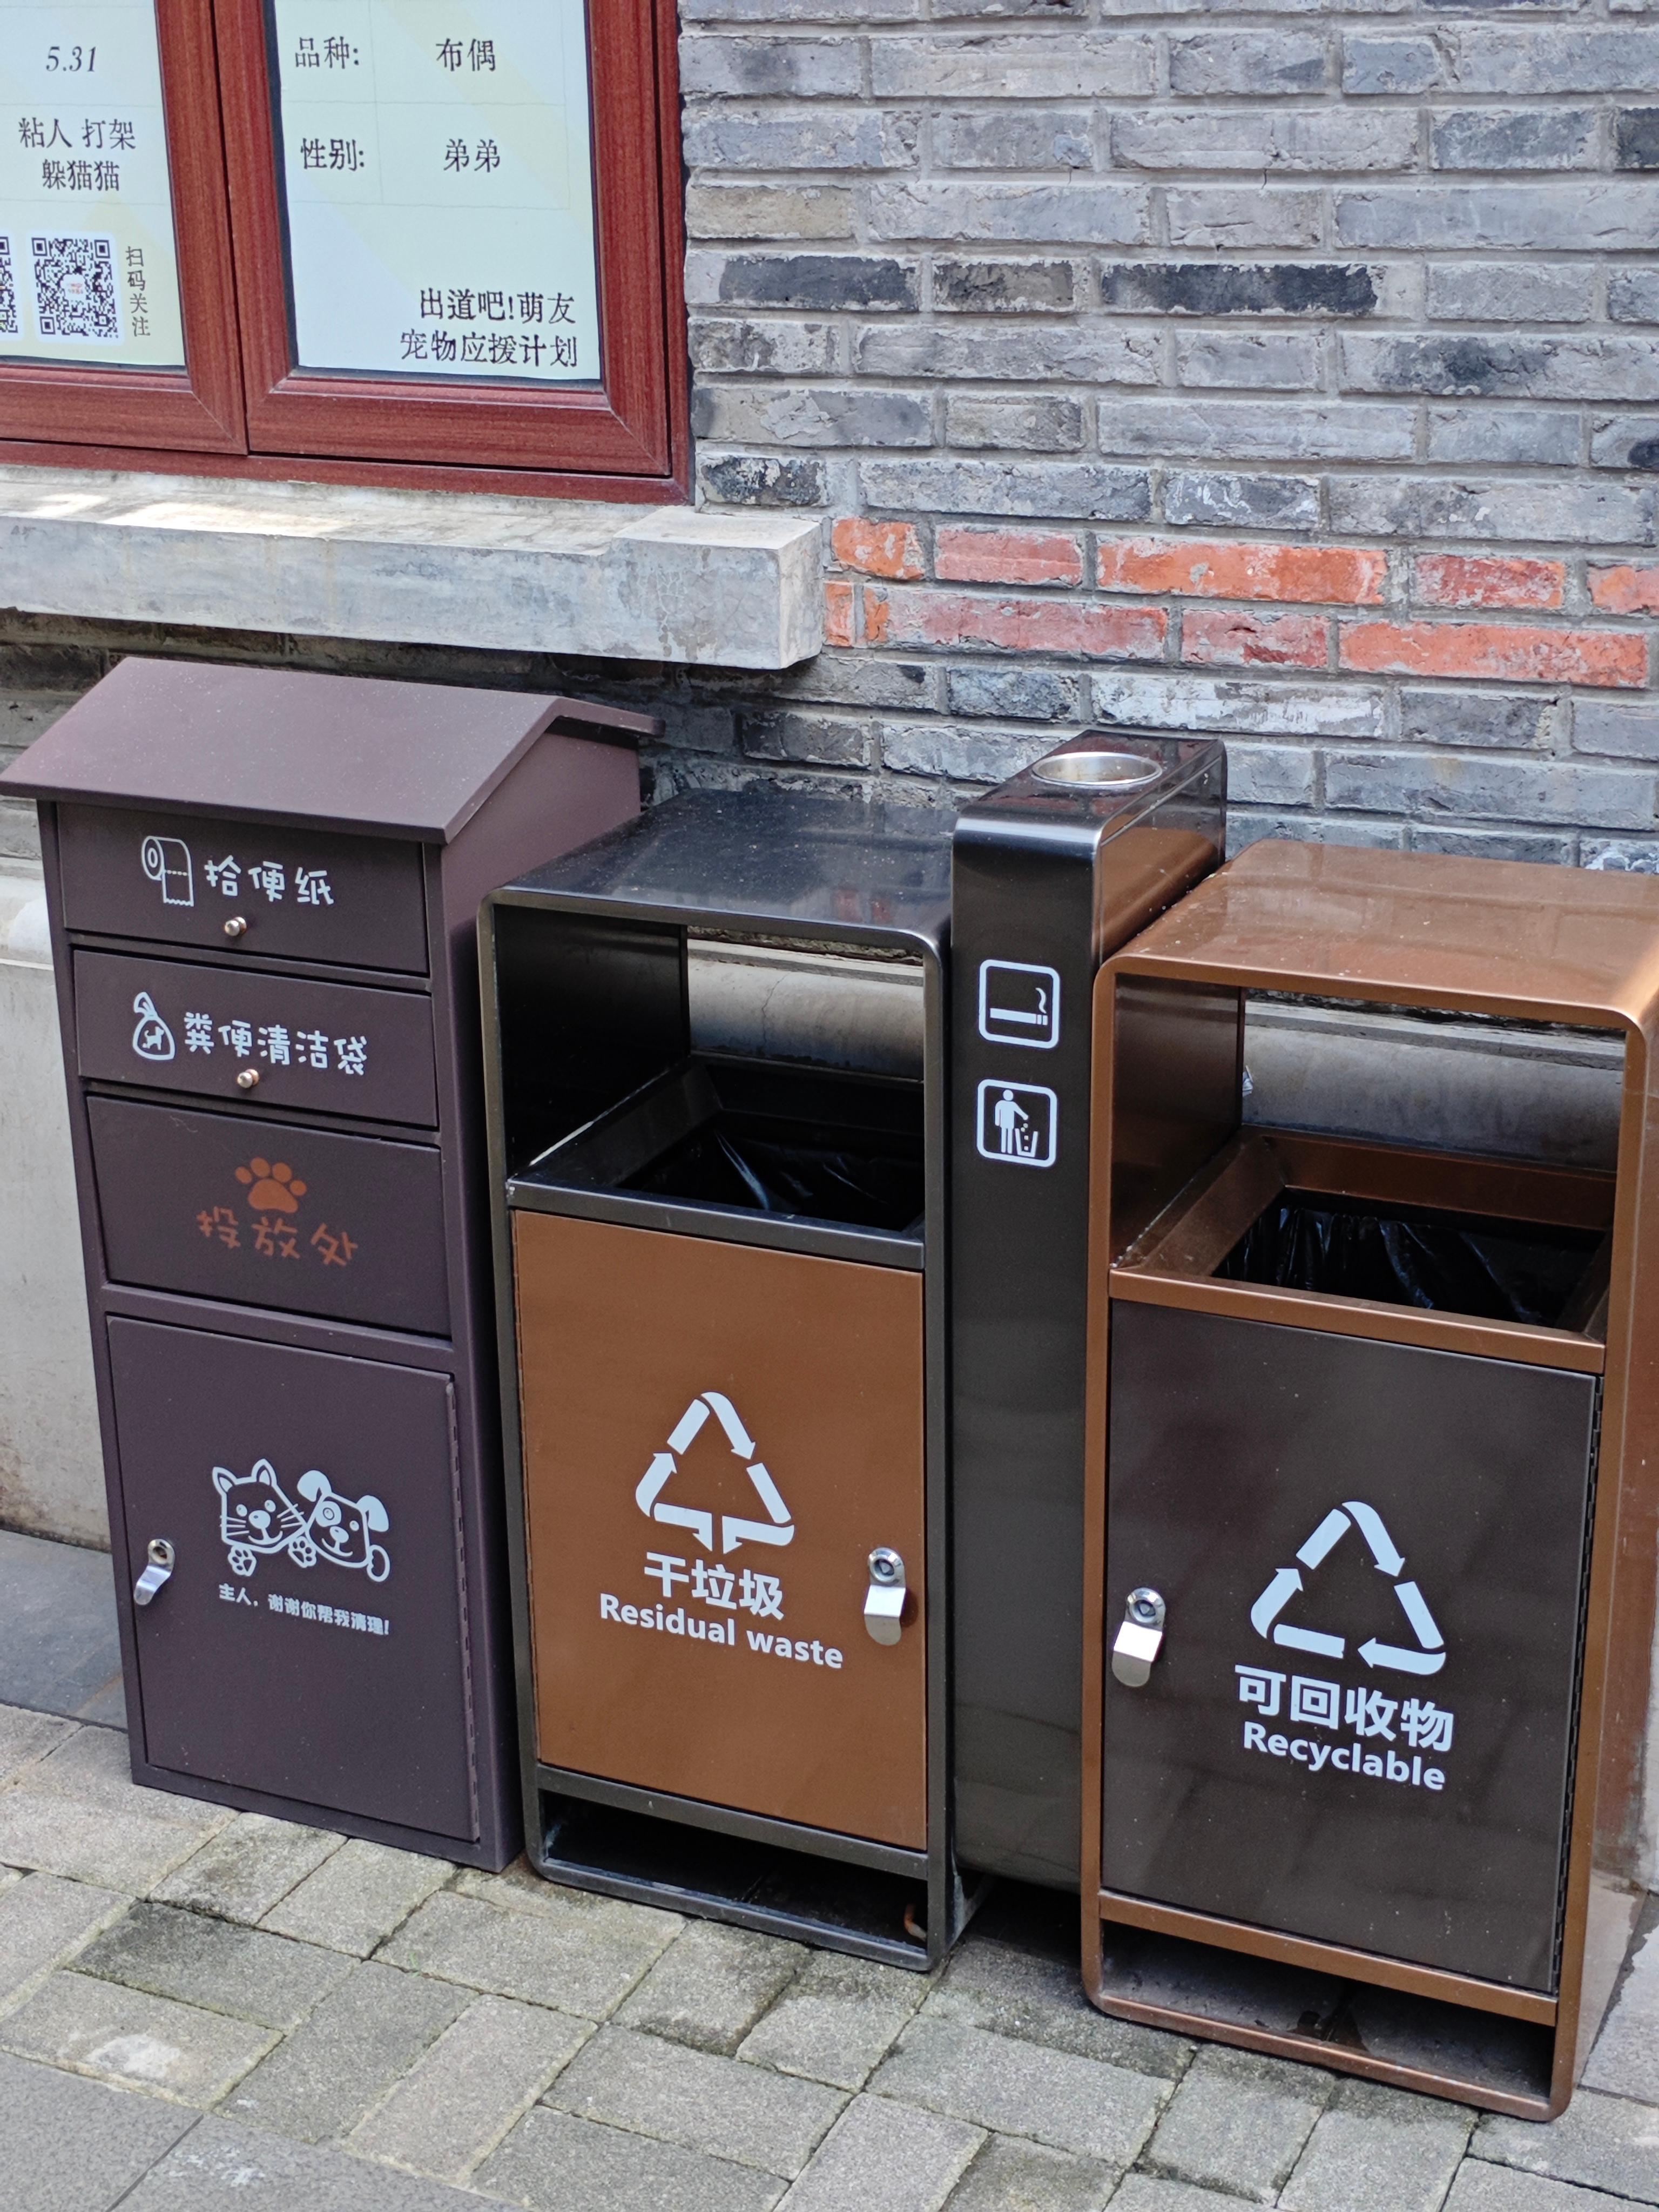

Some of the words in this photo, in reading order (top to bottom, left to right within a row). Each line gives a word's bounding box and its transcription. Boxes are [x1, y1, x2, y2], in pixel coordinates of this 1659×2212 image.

[46, 46, 96, 71] 5.31
[436, 38, 496, 71] 布偶
[19, 117, 72, 148] 粘人
[82, 119, 136, 150] 打架
[444, 139, 500, 173] 弟弟
[42, 159, 119, 191] 躲猫猫
[126, 246, 150, 336] 扫码关注
[401, 328, 577, 367] 宠物应援计划
[204, 855, 334, 905] 拾便纸
[184, 1012, 367, 1076] 粪便清洁袋
[196, 1206, 358, 1266] 投放处
[644, 1552, 784, 1620] 干垃圾
[600, 1593, 735, 1645] Residual
[746, 1630, 842, 1668] waste
[1235, 1664, 1454, 1752] 可回收物
[1244, 1721, 1445, 1791] Recyclable
